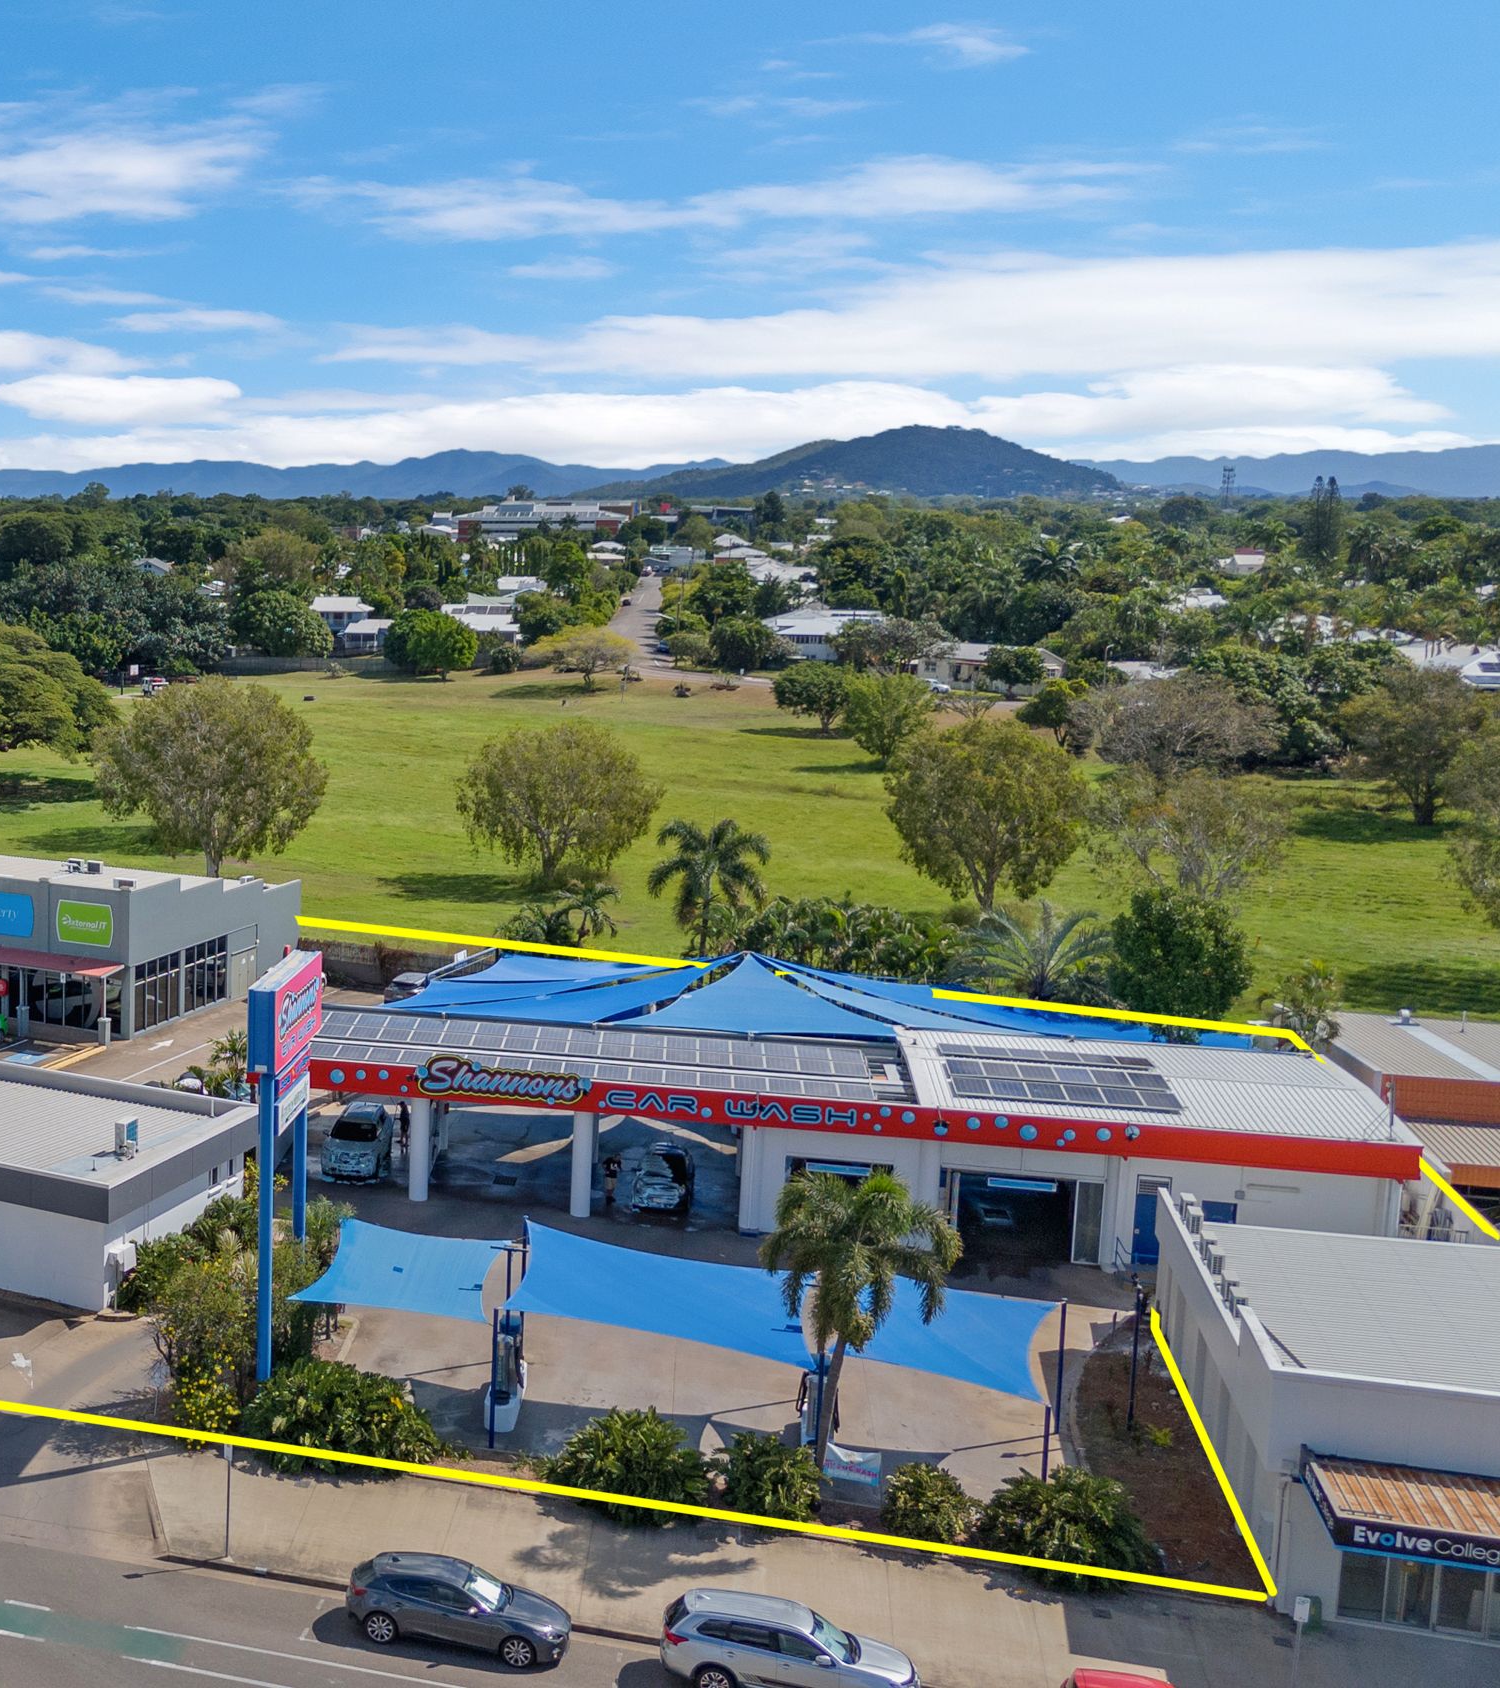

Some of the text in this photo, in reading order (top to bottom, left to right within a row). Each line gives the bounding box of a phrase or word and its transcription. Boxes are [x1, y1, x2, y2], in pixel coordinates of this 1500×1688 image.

[423, 1060, 577, 1099] Shannons
[605, 1089, 858, 1127] CAR WASH
[1353, 1525, 1432, 1552] Evolve
